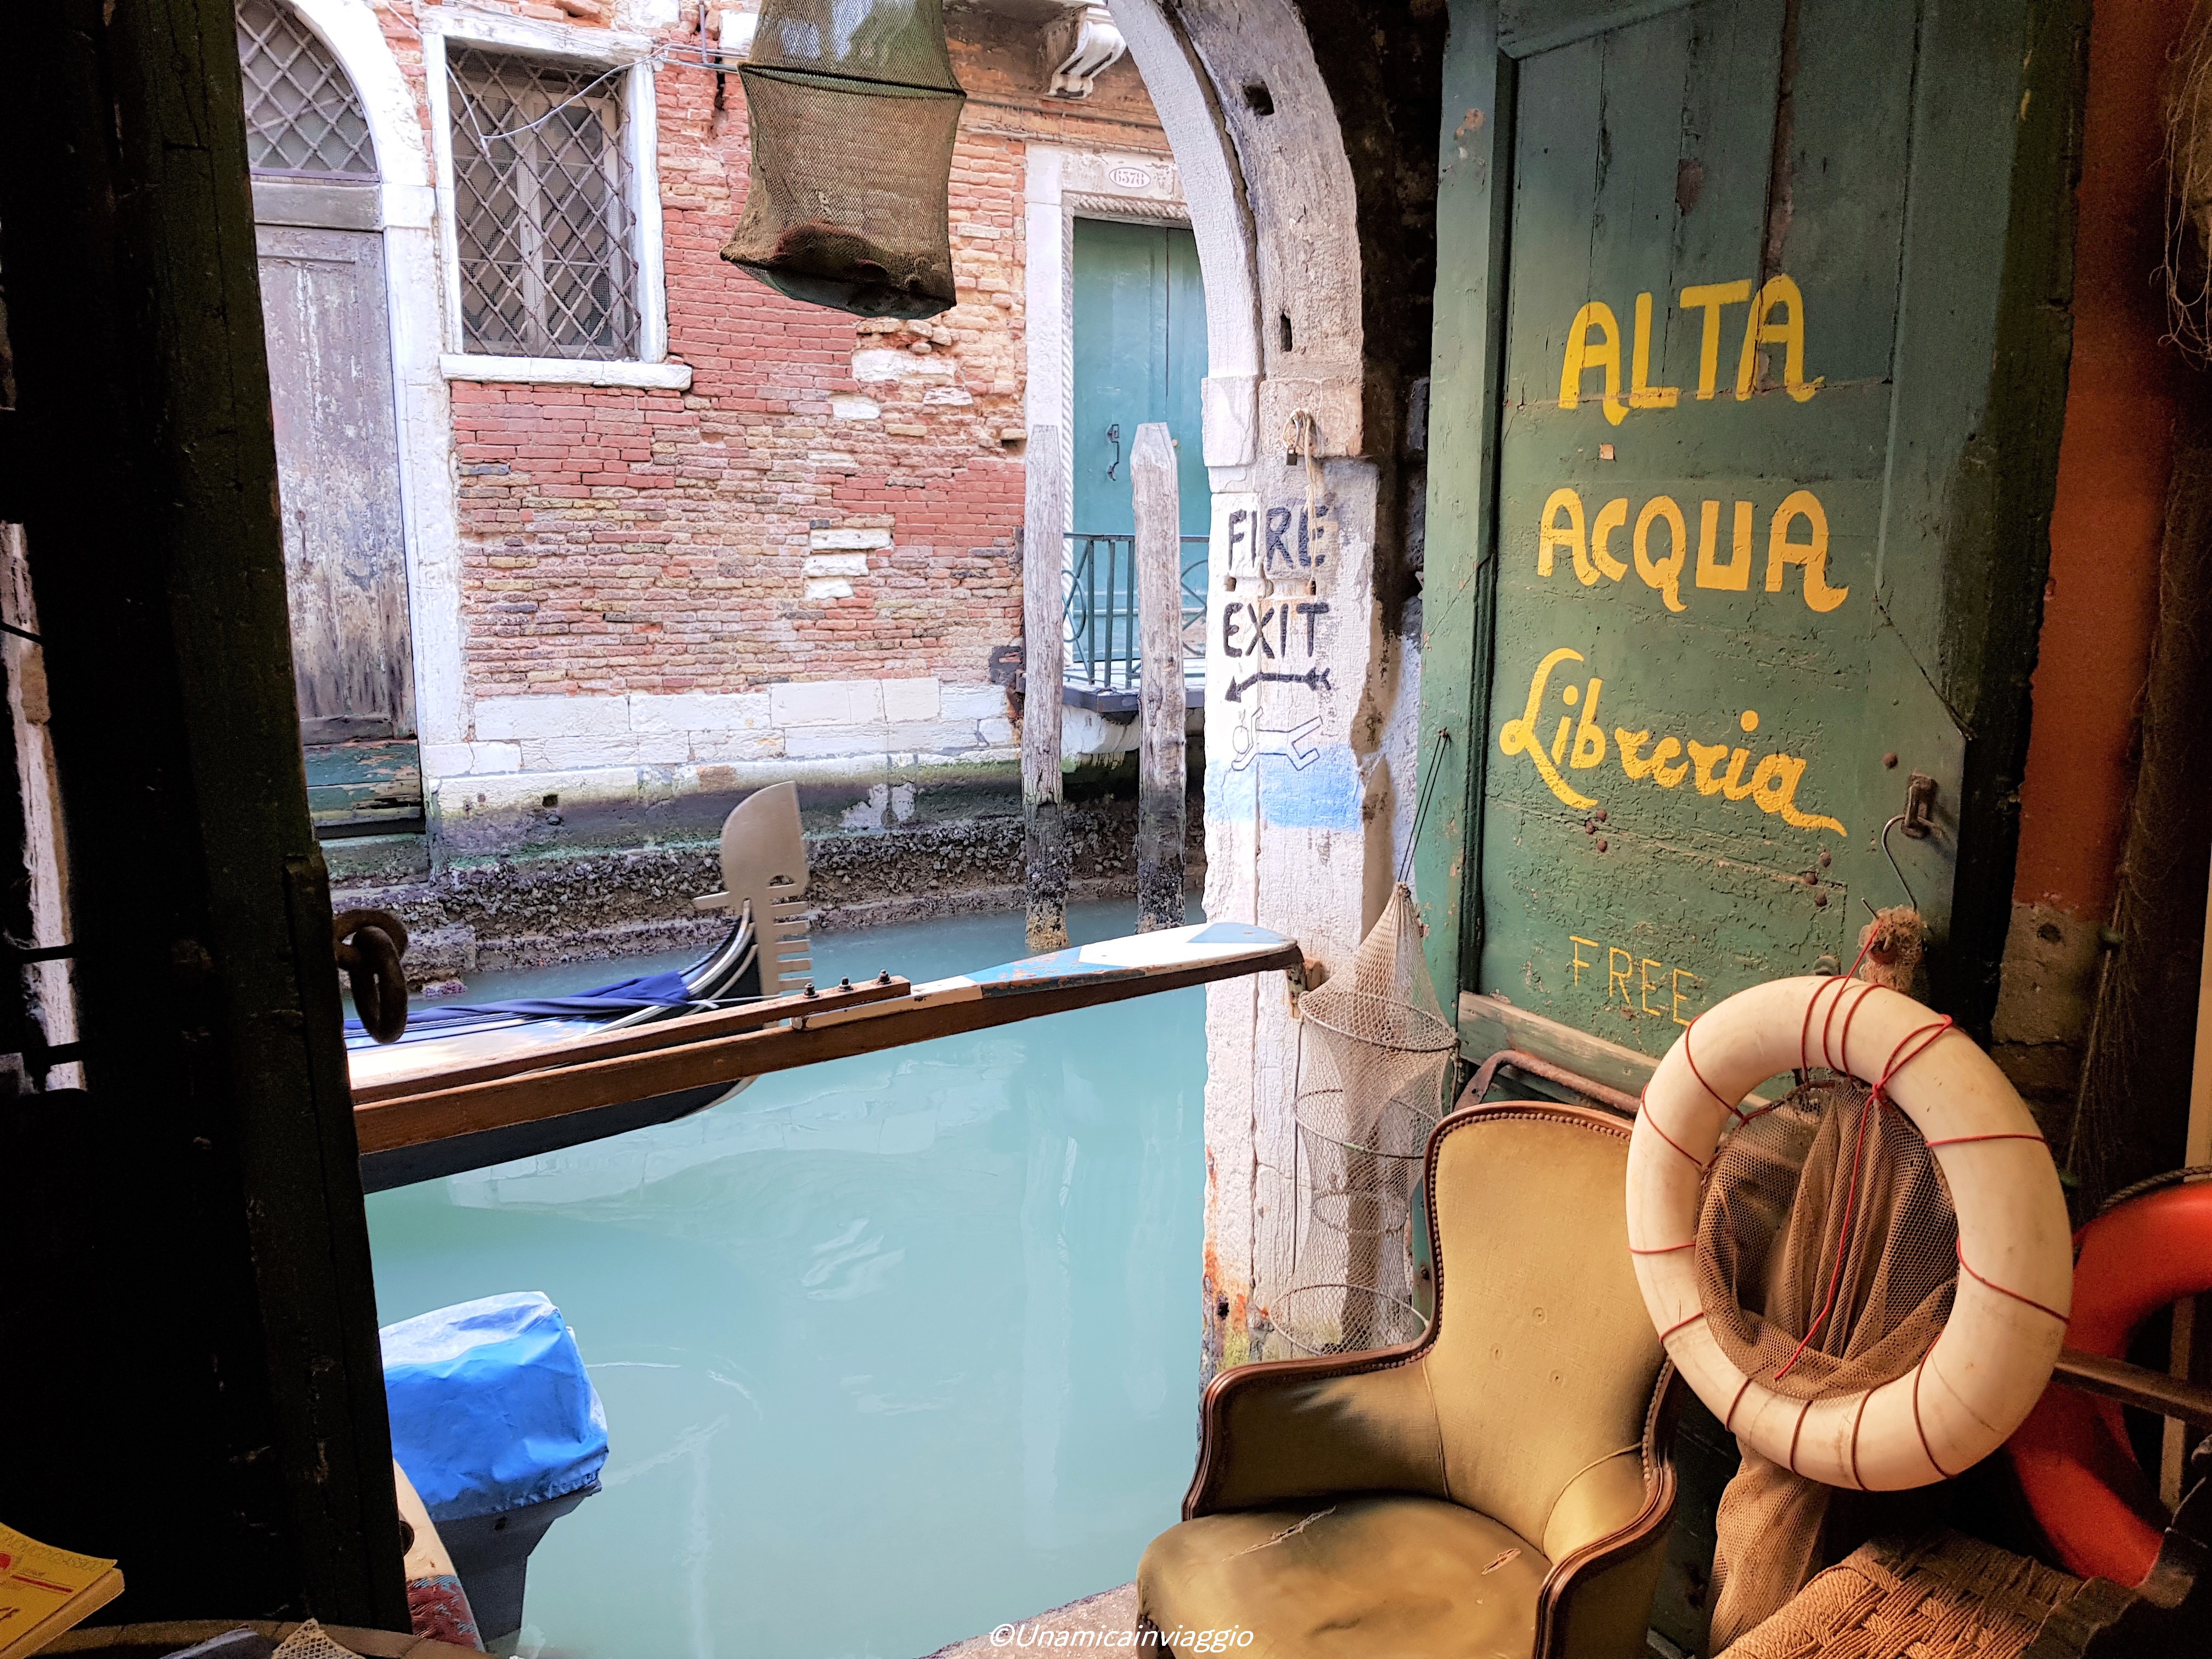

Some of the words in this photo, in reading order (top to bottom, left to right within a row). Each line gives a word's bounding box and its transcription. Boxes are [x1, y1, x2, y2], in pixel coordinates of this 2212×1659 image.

[1114, 170, 1144, 185] 6378
[1558, 272, 1826, 426] ALTA
[1228, 505, 1329, 571] FIRE
[1537, 487, 1849, 613] ACQUA
[1223, 602, 1329, 659] EXIT
[1499, 647, 1848, 837] Libreria
[1568, 934, 1702, 1026] FREE
